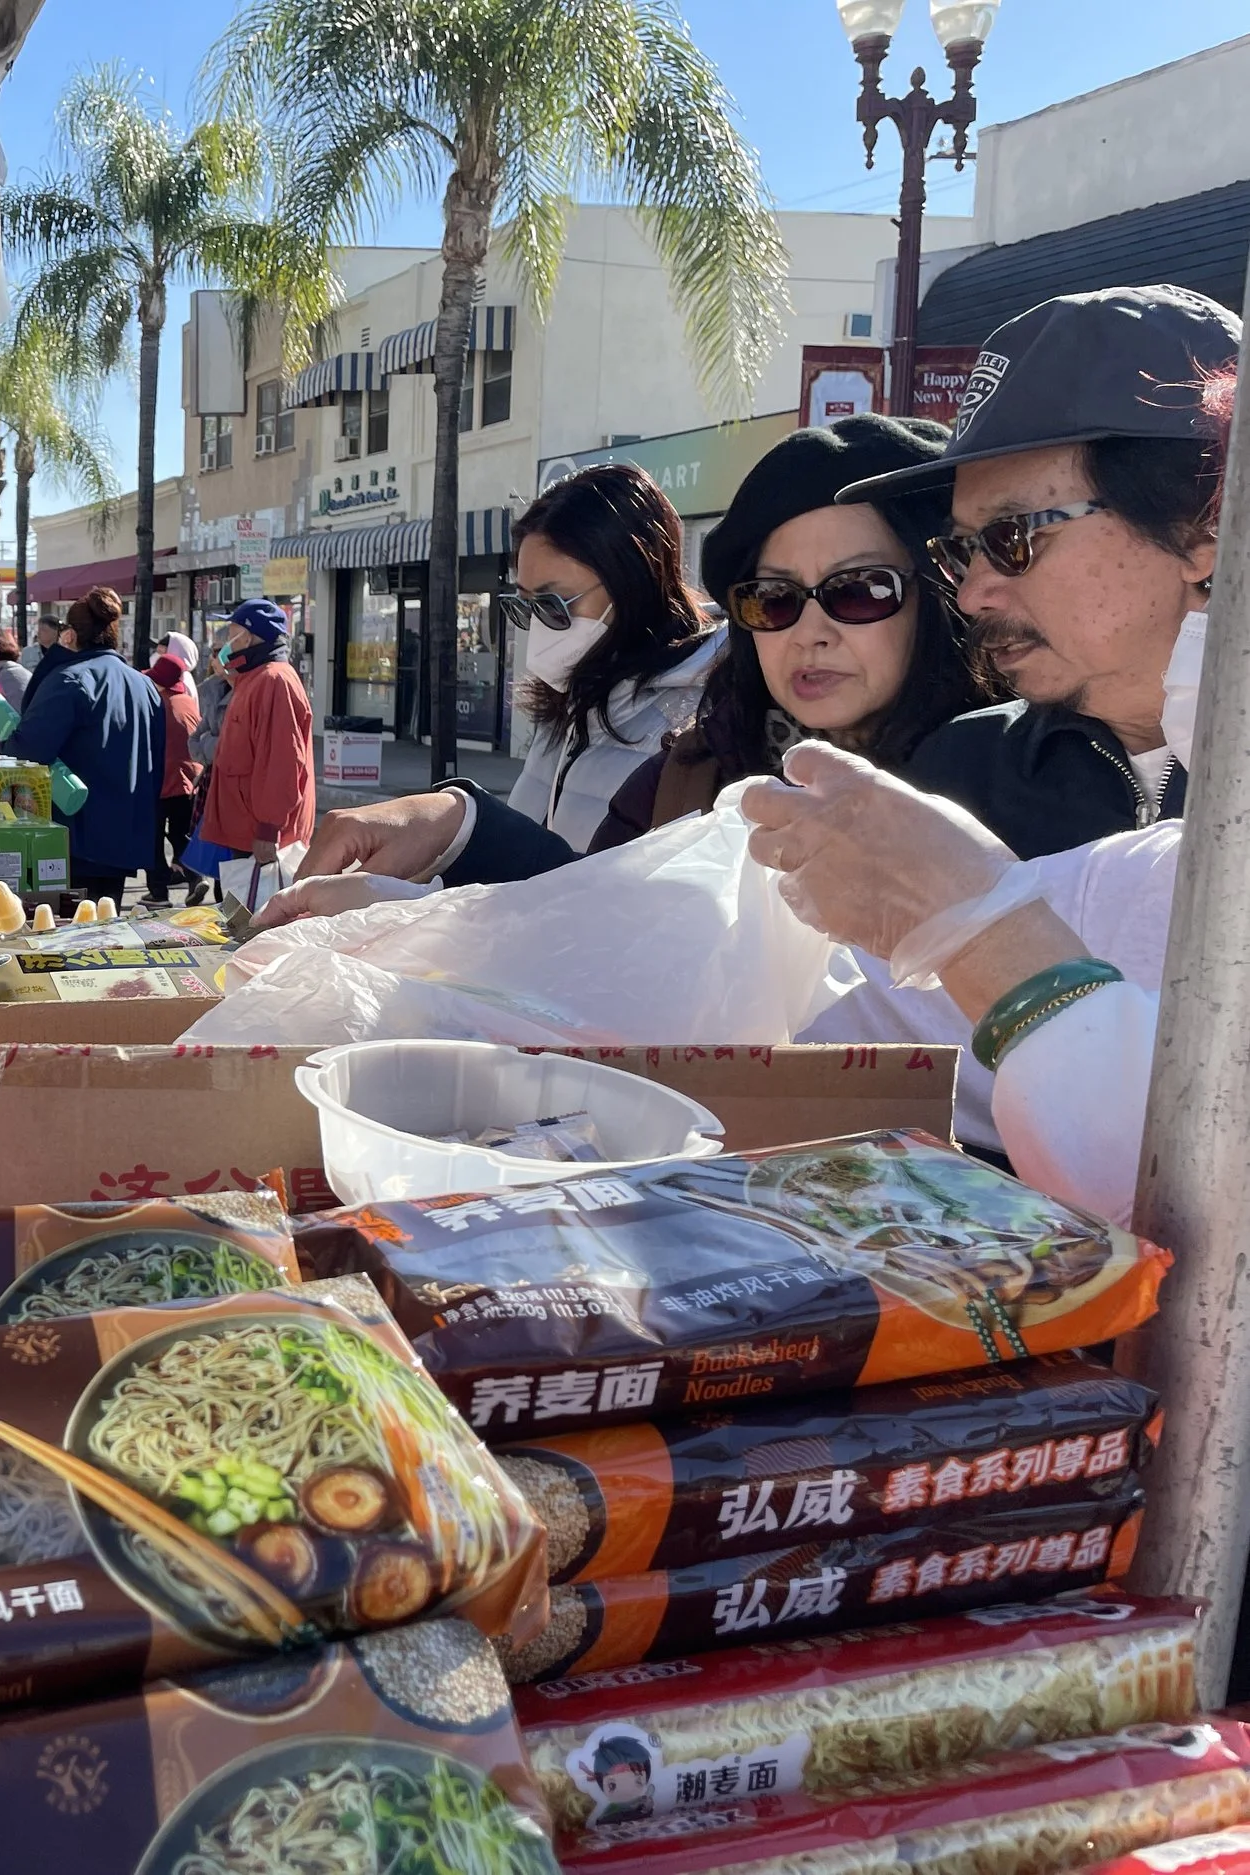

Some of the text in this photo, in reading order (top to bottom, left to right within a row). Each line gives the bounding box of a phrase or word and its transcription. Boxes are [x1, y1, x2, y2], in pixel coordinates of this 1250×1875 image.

[913, 390, 943, 404] New
[923, 372, 967, 388] Happy
[423, 1178, 646, 1232] 荞麦面
[659, 1266, 824, 1312] 非油炸风干面
[688, 1334, 820, 1376] Buckwheat
[471, 1361, 665, 1428] 荞麦面
[682, 1372, 775, 1403] Noodles
[716, 1427, 1130, 1541] 弘威 素食系列尊品
[711, 1525, 1112, 1636] 弘威 素食系列尊品
[676, 1758, 779, 1803] 潮麦面
